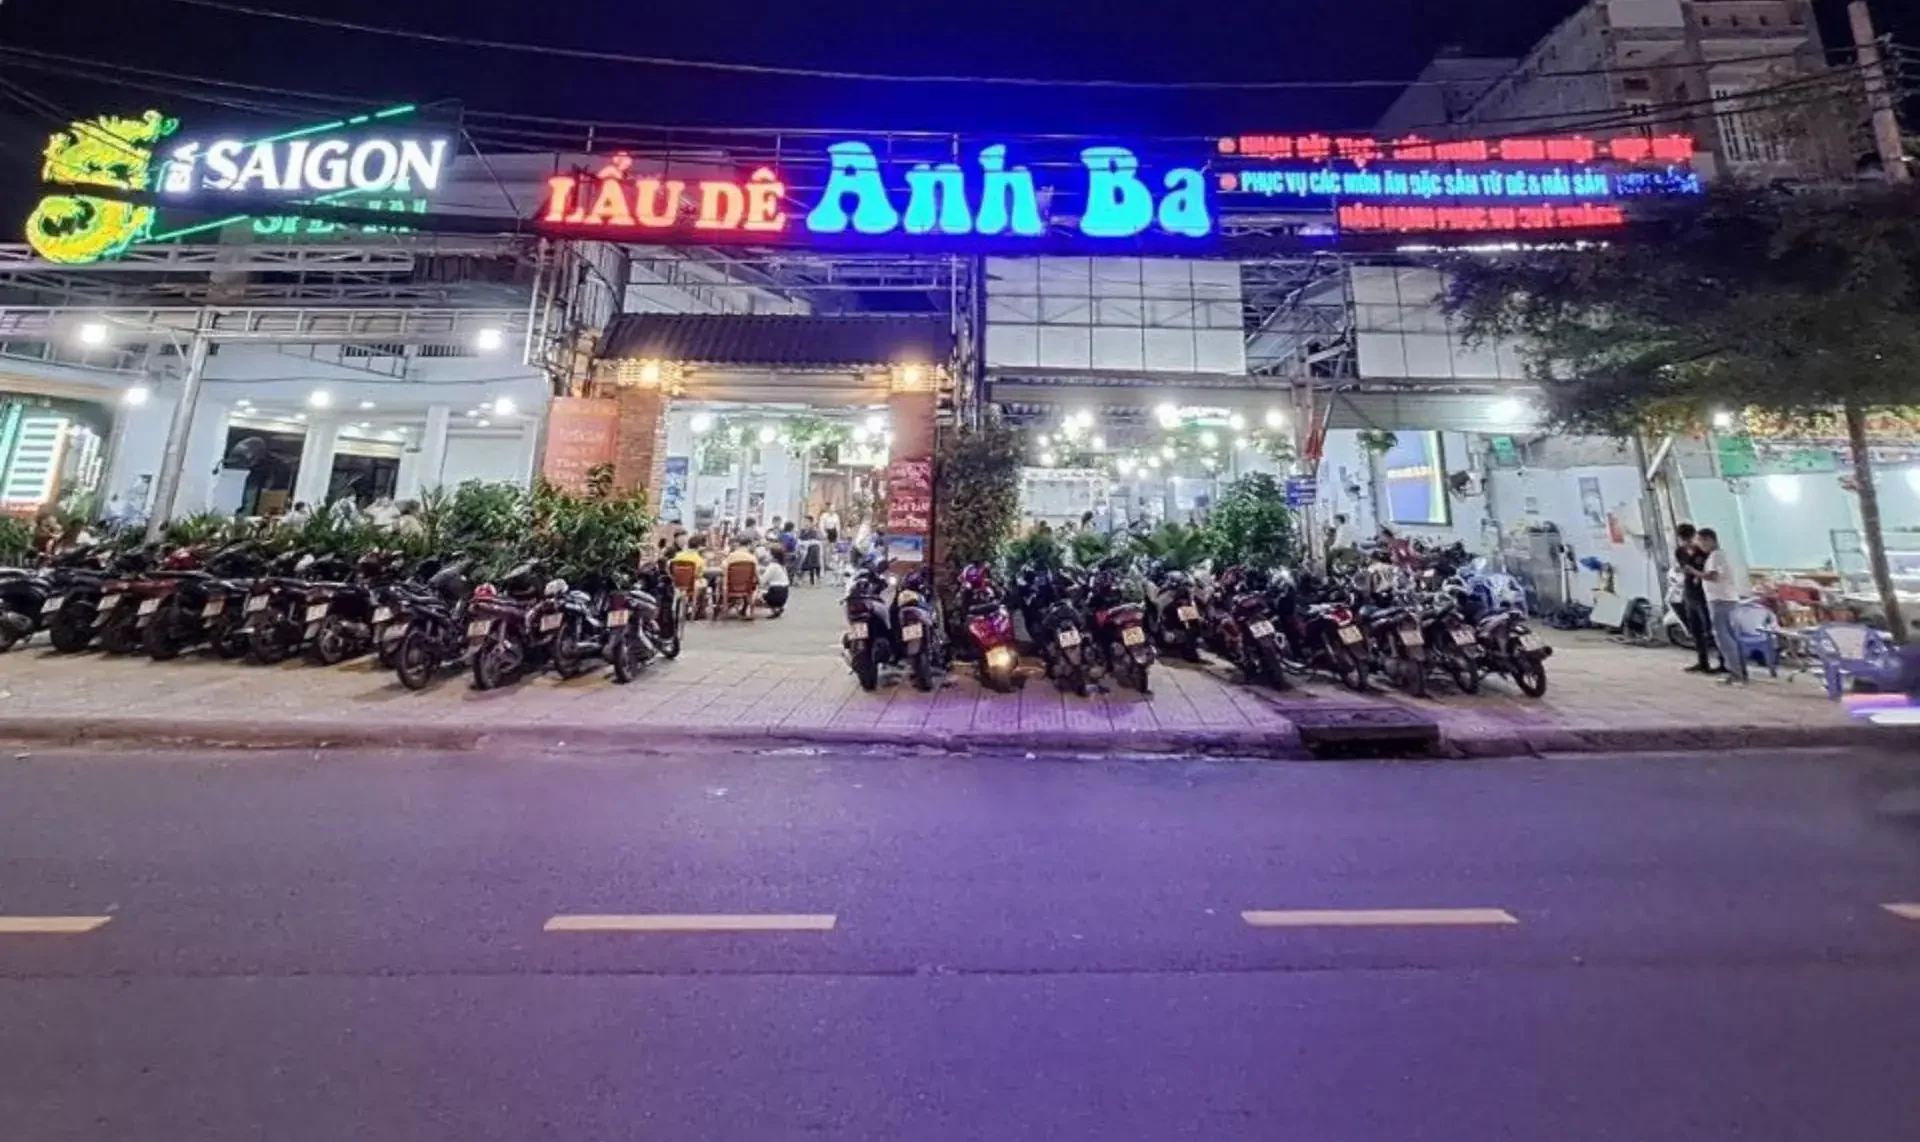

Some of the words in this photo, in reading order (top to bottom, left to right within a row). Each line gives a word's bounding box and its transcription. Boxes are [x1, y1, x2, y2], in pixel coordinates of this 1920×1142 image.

[202, 140, 447, 191] SAIGON
[544, 151, 685, 227] LẨU
[695, 167, 787, 231] DÊ
[806, 141, 1041, 235] Anh
[1080, 146, 1211, 237] Ba
[1241, 171, 1284, 197] PHỤC
[1285, 171, 1307, 197] VỤ
[1309, 168, 1341, 194] CÁC
[1343, 168, 1381, 194] MÓN
